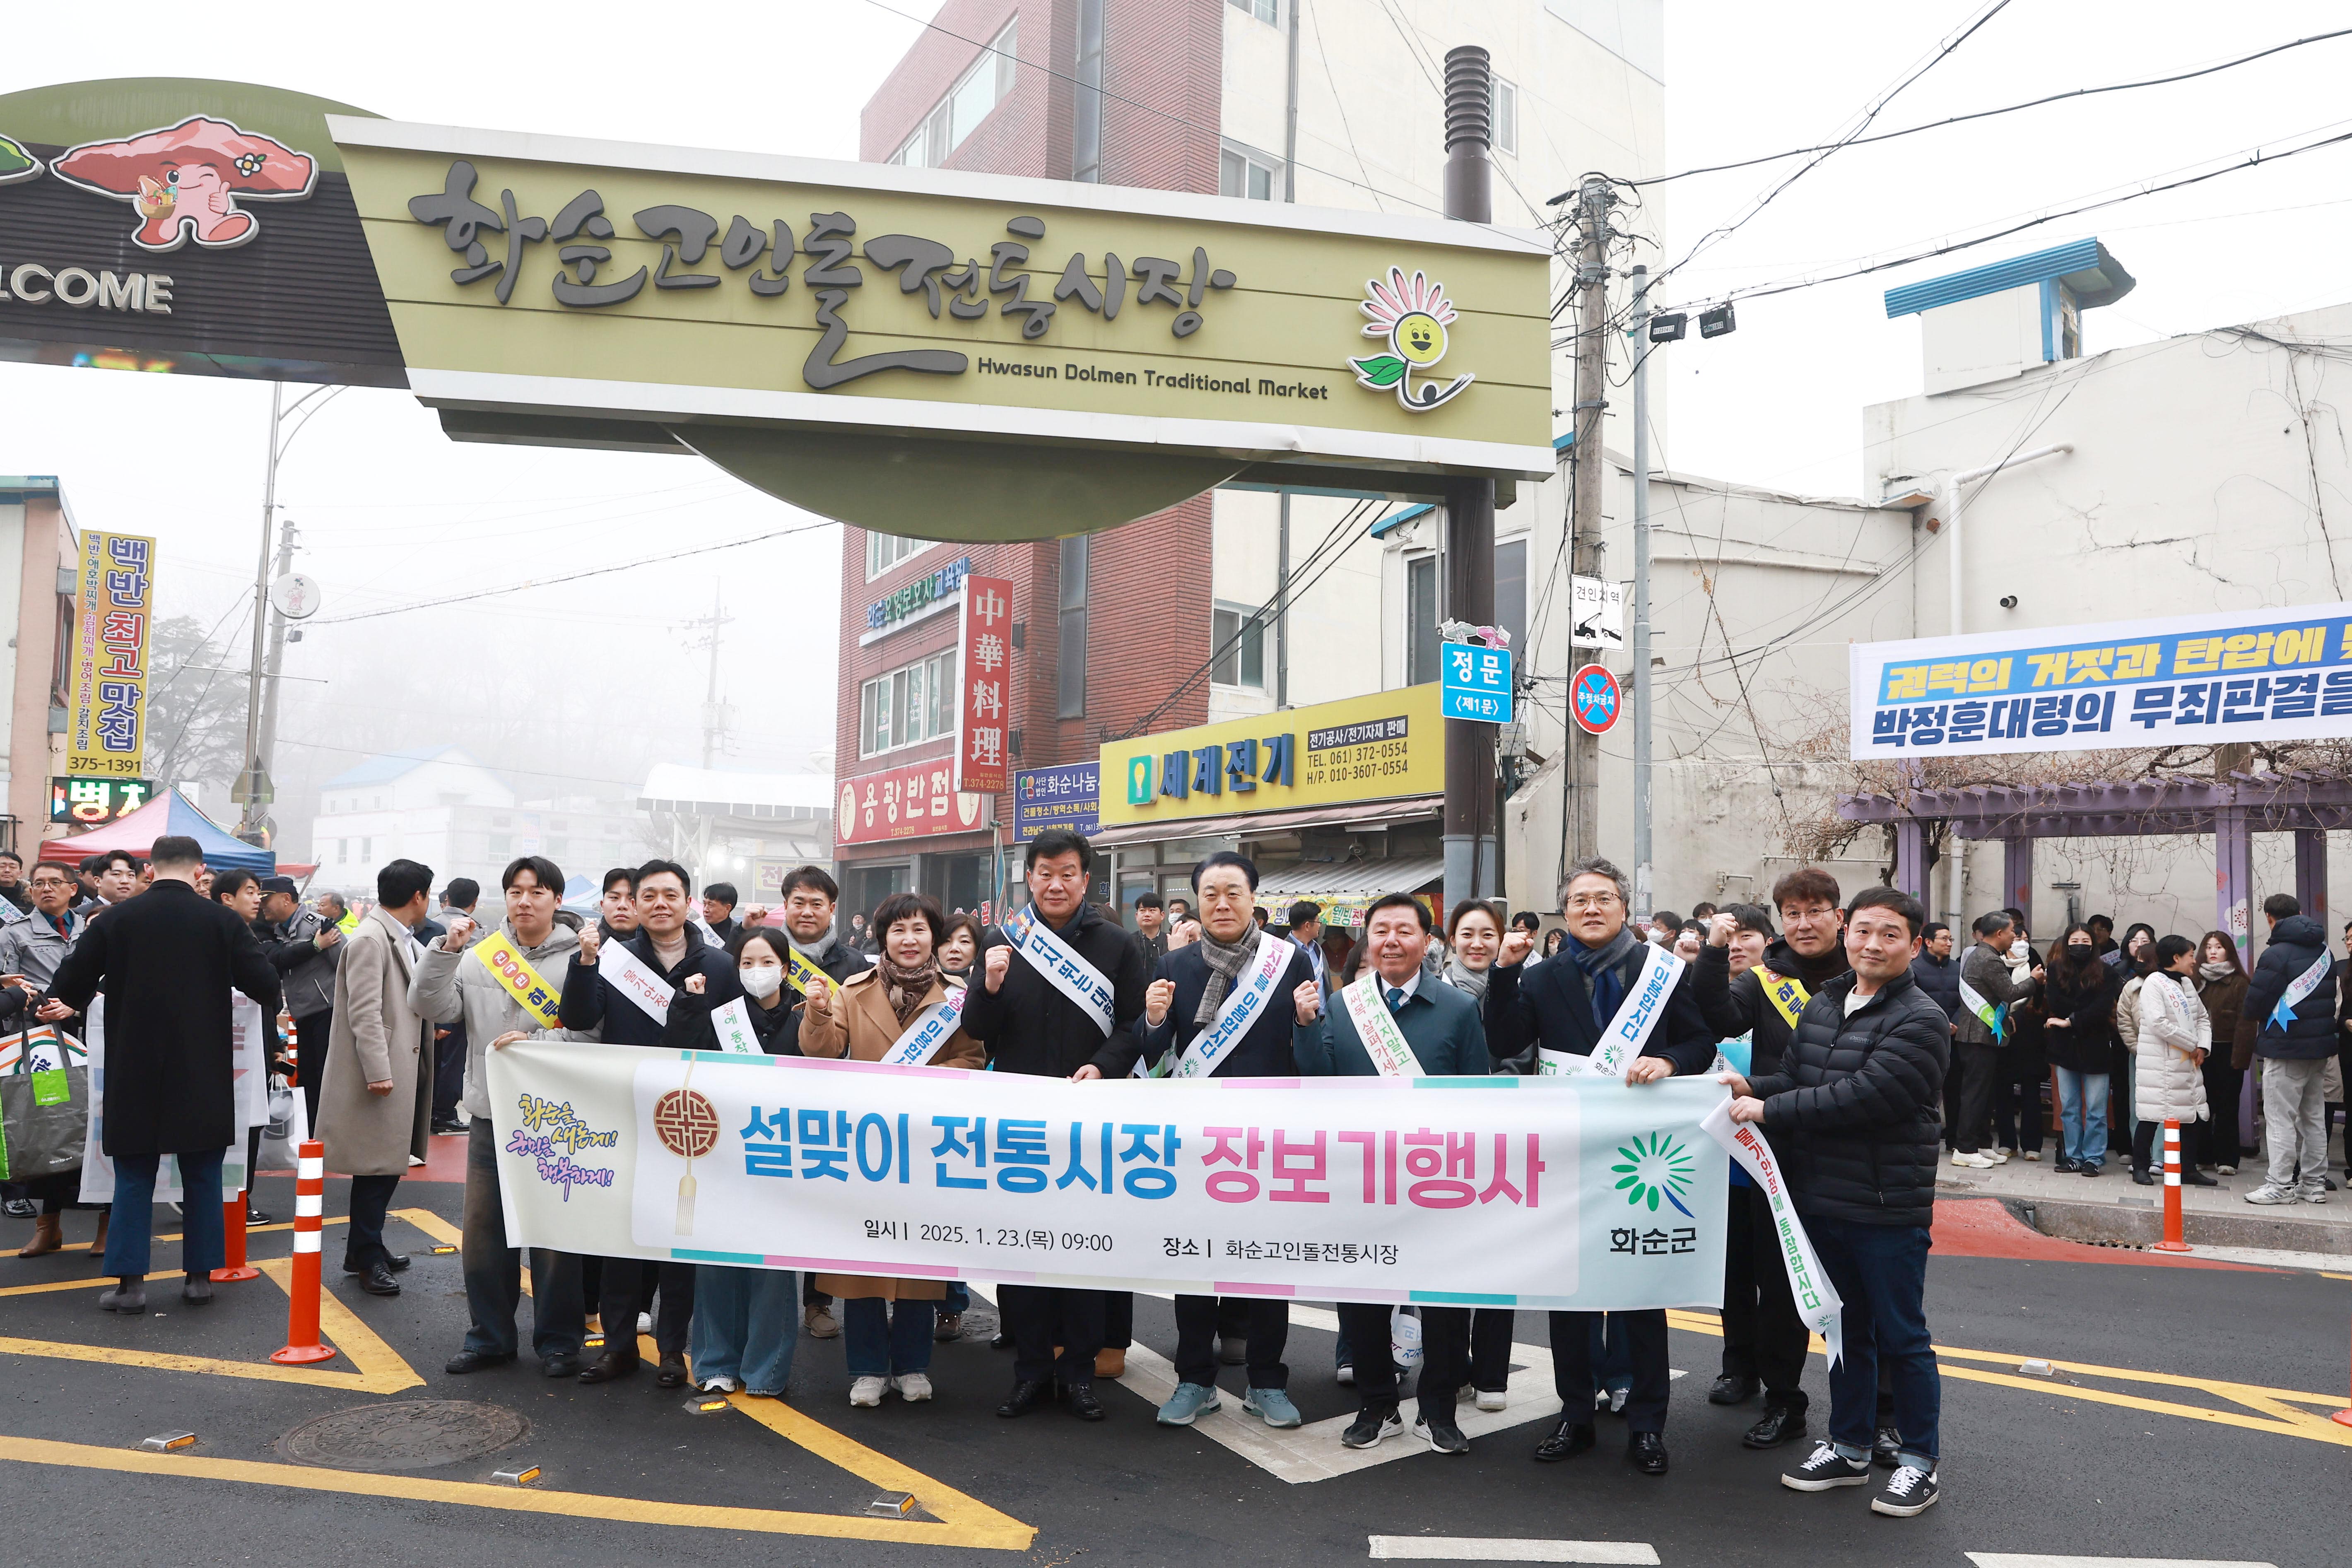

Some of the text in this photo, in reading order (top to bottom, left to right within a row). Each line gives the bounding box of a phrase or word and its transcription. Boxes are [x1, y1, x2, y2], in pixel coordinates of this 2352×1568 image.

[408, 160, 1236, 390] 화순고인돌전통시장
[978, 357, 1328, 401] Hwasun Dolmen Traditional Market
[1576, 586, 1620, 605] 견인지역
[971, 588, 1005, 767] 中華料理
[1452, 651, 1502, 685] 정문
[1886, 658, 2012, 701] 권력의
[2031, 642, 2161, 687] 거짓과
[2175, 626, 2327, 671] 탄압에
[1578, 691, 1614, 706] 주정차금지
[1310, 718, 1405, 749] 전기공사/전기자재 판매
[1872, 691, 2116, 747] 박정훈대령의
[70, 757, 140, 772] 375-1391
[1159, 733, 1294, 799] 세계전기
[1307, 759, 1408, 785] H/P. 010-3607-0554
[1308, 742, 1407, 768] TEL. 061) 372-0554
[861, 767, 949, 828] 용광반점
[1035, 777, 1046, 786] 사단
[1035, 788, 1046, 797] 법인
[1047, 771, 1100, 795] 화순나눔
[1620, 966, 1670, 1043] 이용합시다
[1200, 991, 1260, 1060] 이용합시다
[1373, 1011, 1411, 1067] 가지말고
[740, 1106, 1546, 1210] 설맞이 전통시장 장보기행사
[1734, 1127, 1822, 1310] 물가안정에 동참합시다
[920, 1224, 969, 1244] 2025.
[976, 1228, 991, 1245] 1.
[997, 1229, 1054, 1250] 23.(목)
[1061, 1233, 1113, 1251] 09:00
[1226, 1239, 1398, 1265] 화순고인돌전통시장
[1610, 1227, 1697, 1257] 화순군
